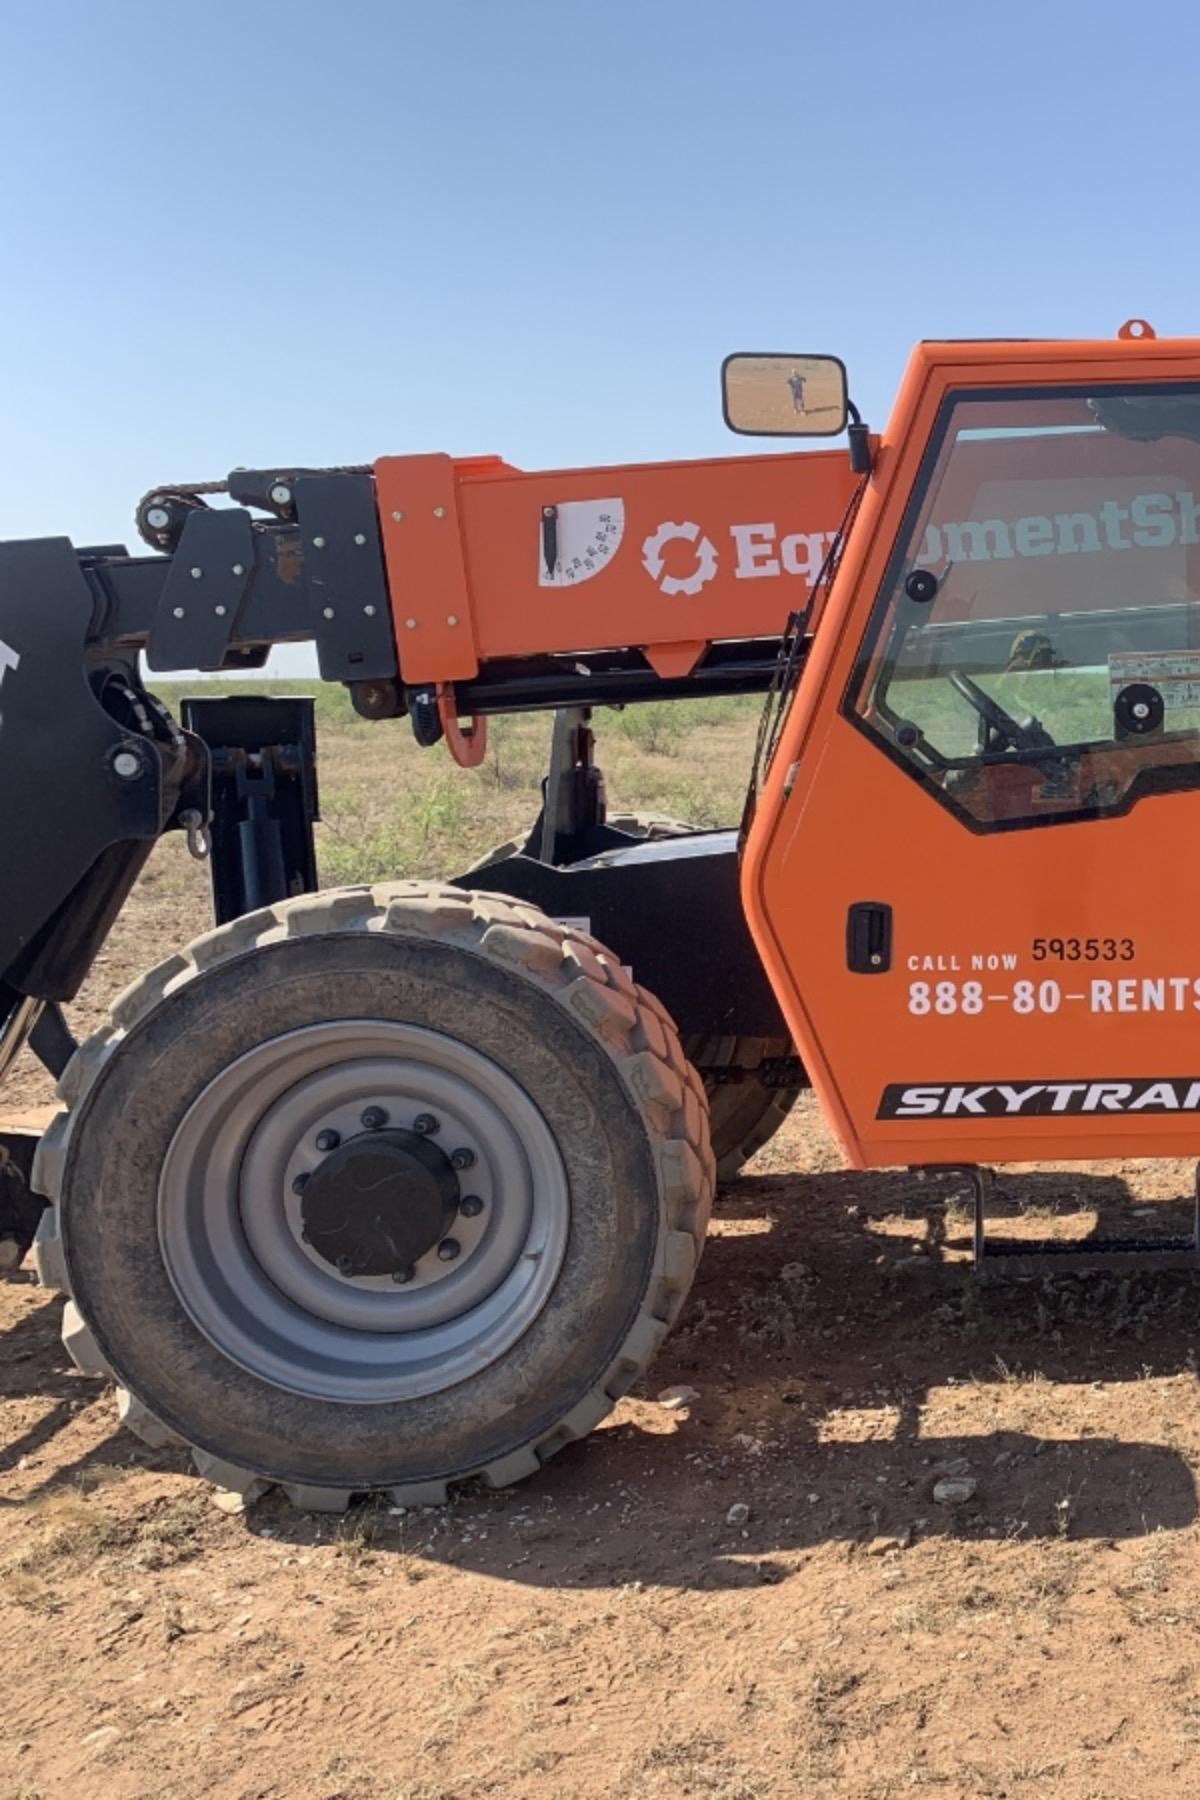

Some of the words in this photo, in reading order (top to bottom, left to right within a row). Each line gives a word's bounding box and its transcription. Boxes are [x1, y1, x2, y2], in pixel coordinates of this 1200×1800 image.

[1032, 938, 1135, 962] 593533
[907, 954, 960, 972] CALL
[971, 954, 1018, 971] NOW
